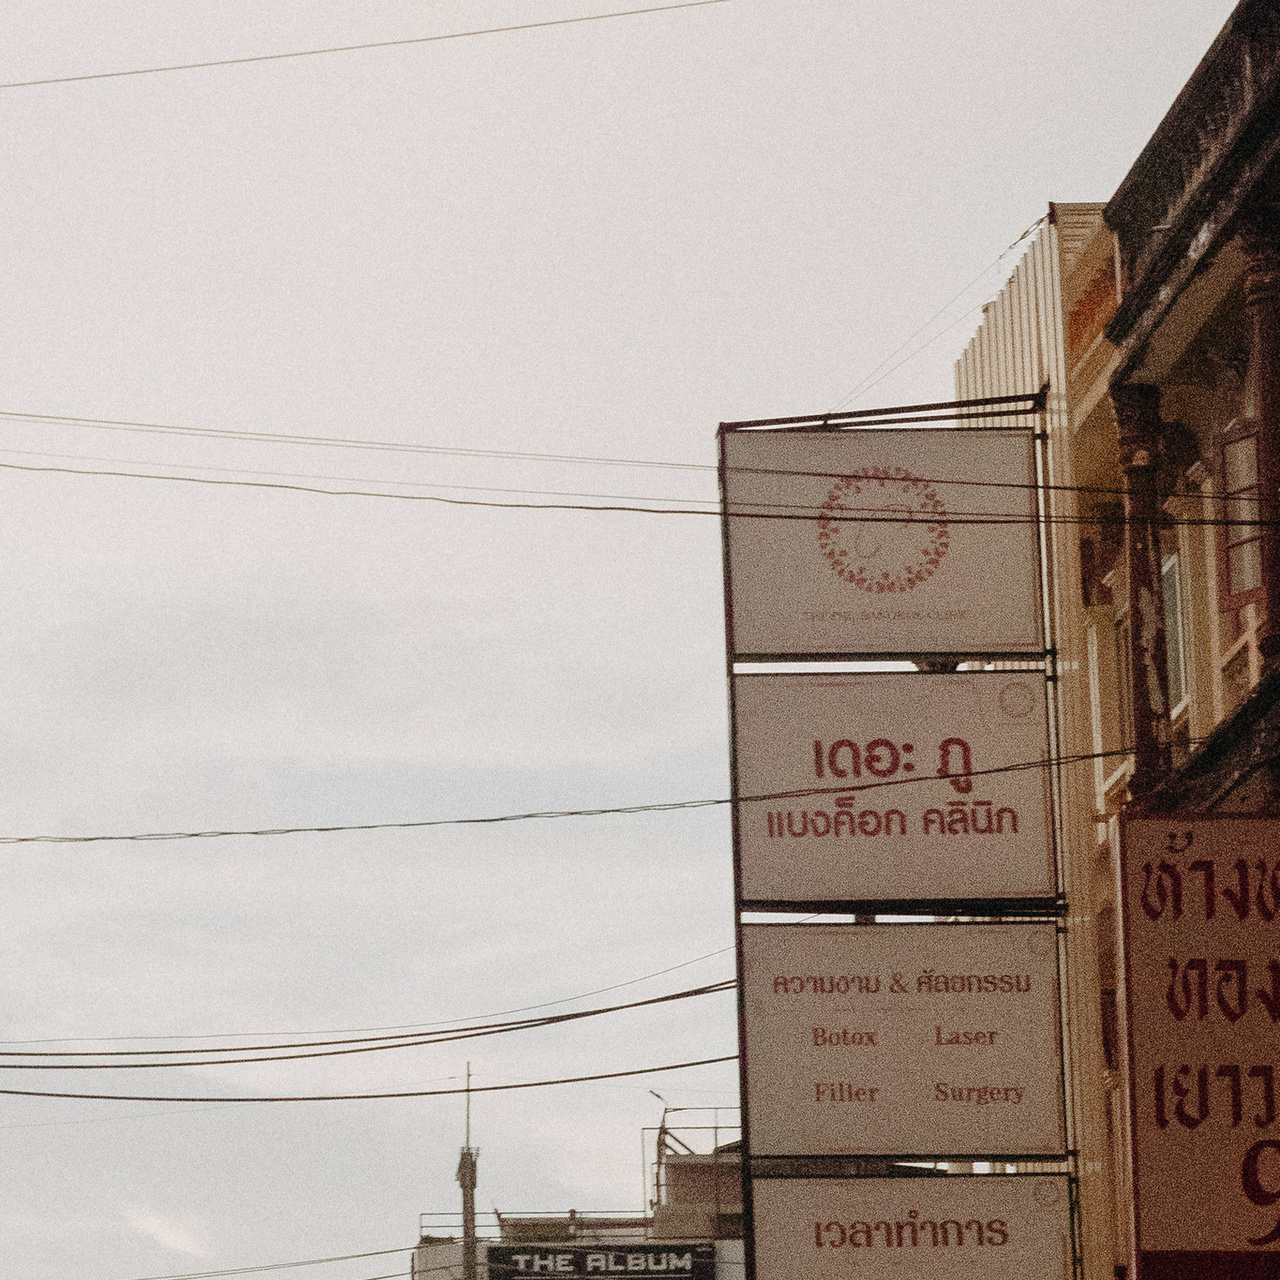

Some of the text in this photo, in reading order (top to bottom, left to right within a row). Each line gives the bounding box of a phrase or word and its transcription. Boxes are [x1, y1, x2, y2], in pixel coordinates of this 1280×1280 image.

[813, 738, 973, 793] เดอะ ภู
[766, 796, 1018, 838] แบงค็อก คลินิก
[772, 969, 1031, 995] ความงาม & ศัลยกรรม
[811, 1025, 999, 1047] Botox Laser
[814, 1082, 1025, 1105] Filler Surgery
[813, 1210, 1010, 1249] เวลาทำการ
[511, 1251, 693, 1272] THE ALBUM
